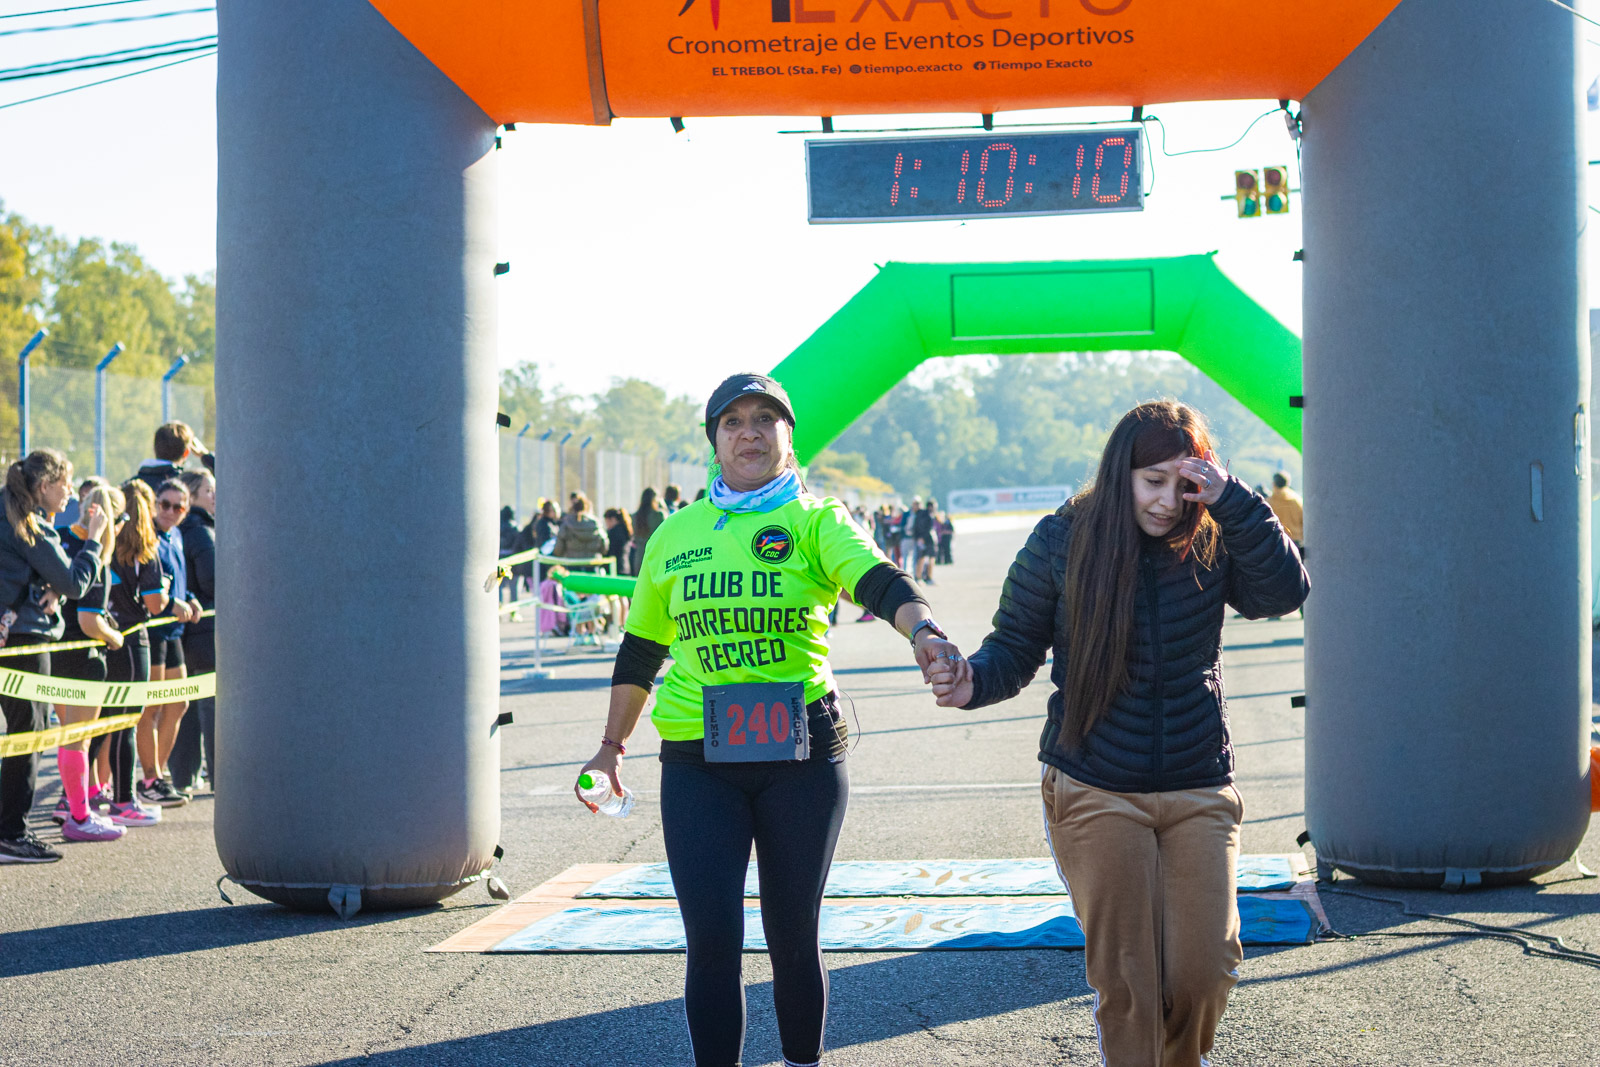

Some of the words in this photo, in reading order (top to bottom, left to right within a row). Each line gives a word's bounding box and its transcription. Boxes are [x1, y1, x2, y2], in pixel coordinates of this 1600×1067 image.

[667, 34, 838, 56] Cronometraje
[845, 31, 877, 51] de
[885, 31, 984, 50] Eventos
[992, 26, 1134, 50] Deportivos
[712, 67, 728, 76] EL
[730, 66, 784, 76] TREBOL
[787, 65, 818, 76] (Sta.
[821, 64, 842, 75] Fe)
[864, 63, 963, 75] tiempo.exacto
[988, 60, 1042, 71] Tiempo
[1046, 58, 1093, 69] Exacto
[665, 547, 713, 569] EMAPUR
[683, 571, 743, 601] CLUB
[752, 571, 783, 598] DE
[36, 685, 86, 699] PRECAUCION
[147, 685, 199, 699] PRECAUCION
[709, 700, 719, 747] TIEMPO
[727, 702, 790, 745] 240
[791, 697, 803, 745] EXACTO
